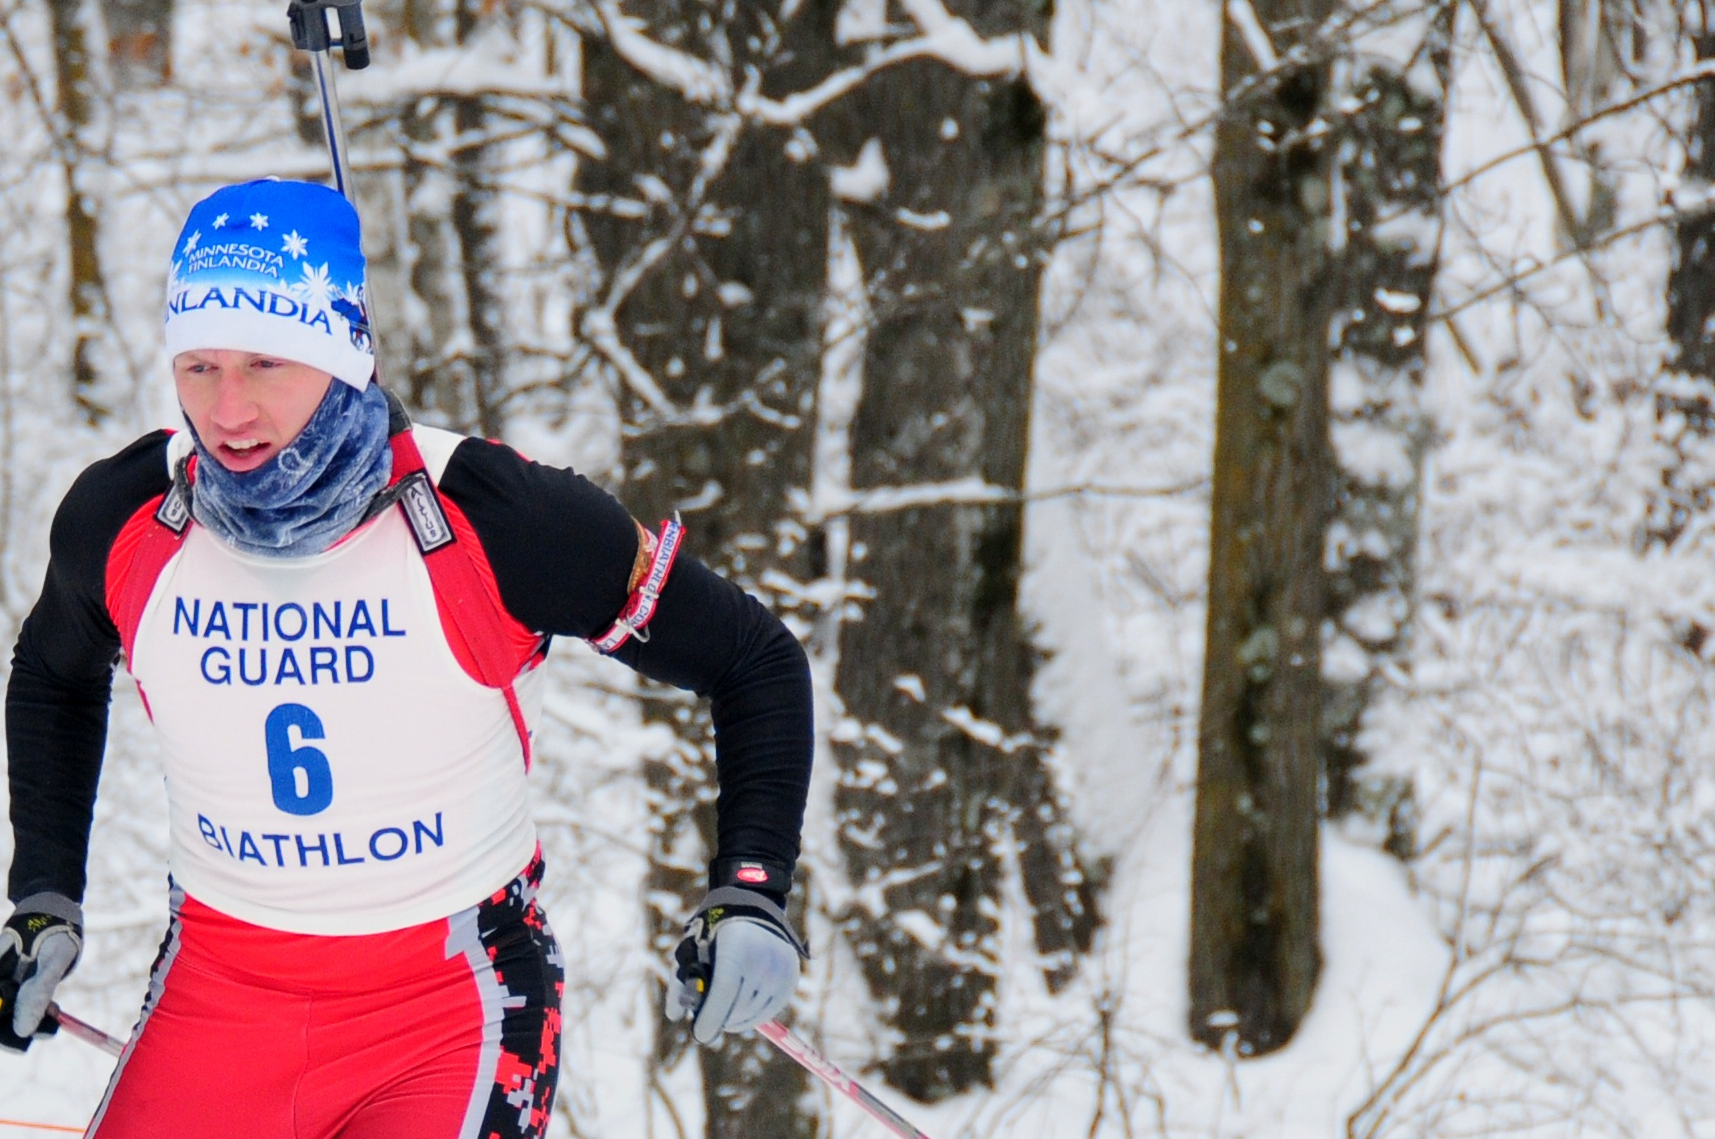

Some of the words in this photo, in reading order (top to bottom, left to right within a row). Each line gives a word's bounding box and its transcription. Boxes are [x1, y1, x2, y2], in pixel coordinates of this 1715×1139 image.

[188, 243, 284, 268] MINNESOTA
[188, 256, 280, 279] FINLANDIA
[173, 596, 406, 641] NATIONAL
[200, 645, 375, 686] GUARD
[265, 702, 334, 816] 6
[197, 811, 445, 867] BIATHLON
